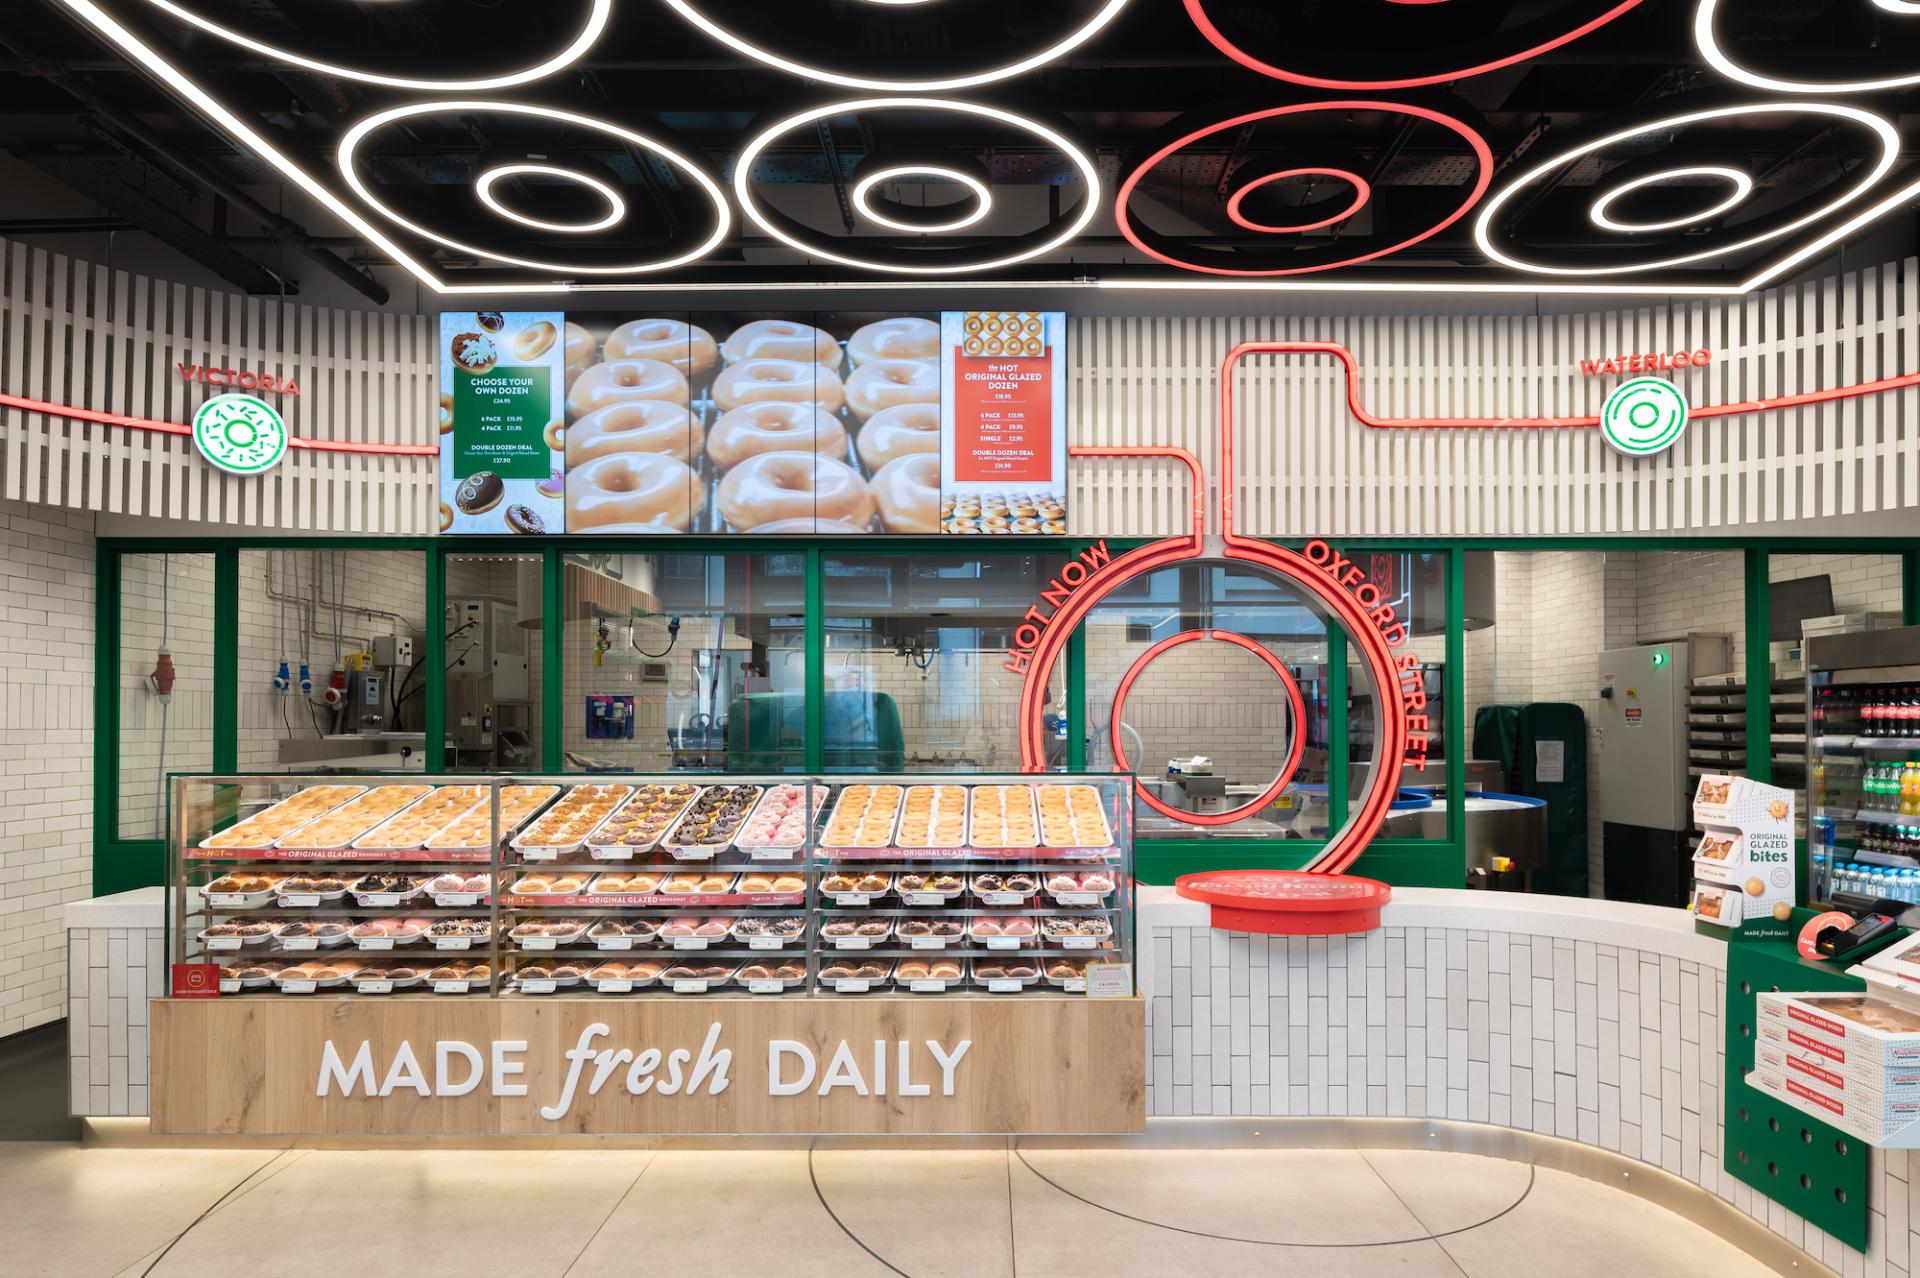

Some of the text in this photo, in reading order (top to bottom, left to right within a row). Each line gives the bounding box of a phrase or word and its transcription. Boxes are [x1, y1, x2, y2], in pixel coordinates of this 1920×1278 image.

[1580, 348, 1711, 376] WATERLOO
[178, 362, 300, 397] VICTORIA
[471, 378, 533, 386] CHOOSE YOUR
[1002, 539, 1110, 675] HOT NOW
[1303, 539, 1428, 772] OXFORD STREET
[1750, 850, 1788, 862] bites
[1789, 1008, 1810, 1019] ORIGINAL
[1810, 1016, 1827, 1026] GLAZED
[1827, 1022, 1843, 1033] DOZEN
[1789, 1033, 1810, 1045] ORIGINAL
[1810, 1041, 1827, 1053] GLAZED
[1827, 1048, 1843, 1060] DOZEN
[316, 1022, 972, 1120] MADE fresh DAILY
[1788, 1058, 1809, 1070] ORIGINAL
[1809, 1067, 1826, 1077] GLAZED
[1826, 1073, 1842, 1083] DOZEN
[1788, 1082, 1809, 1095] ORIGINAL
[1809, 1092, 1825, 1103] GLAZED
[1826, 1099, 1842, 1110] DOZEN
